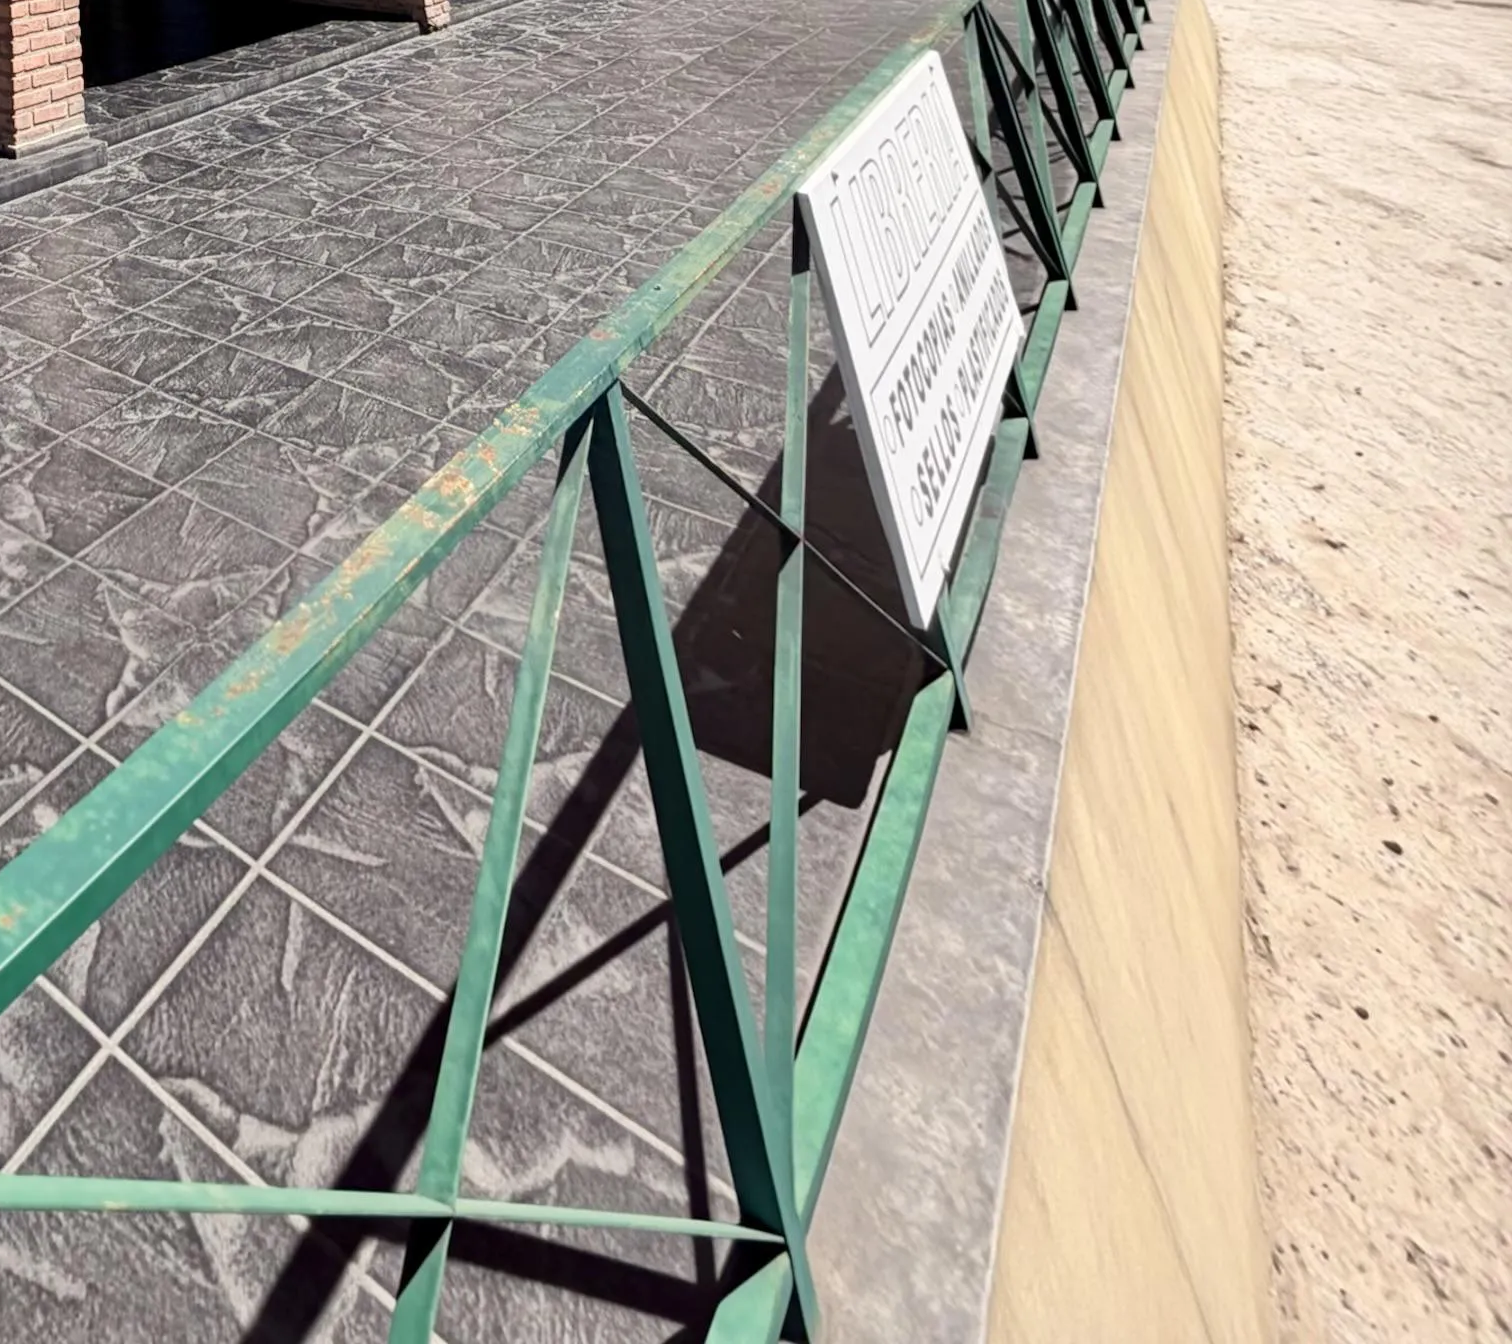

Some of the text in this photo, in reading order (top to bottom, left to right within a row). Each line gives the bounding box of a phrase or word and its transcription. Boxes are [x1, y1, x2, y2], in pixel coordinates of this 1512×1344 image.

[830, 81, 969, 348] LIBRERIA
[889, 209, 992, 447] FOTOCOPIAS ANILLADOS
[916, 268, 1009, 519] SELLOS PLASTIFICADOS
